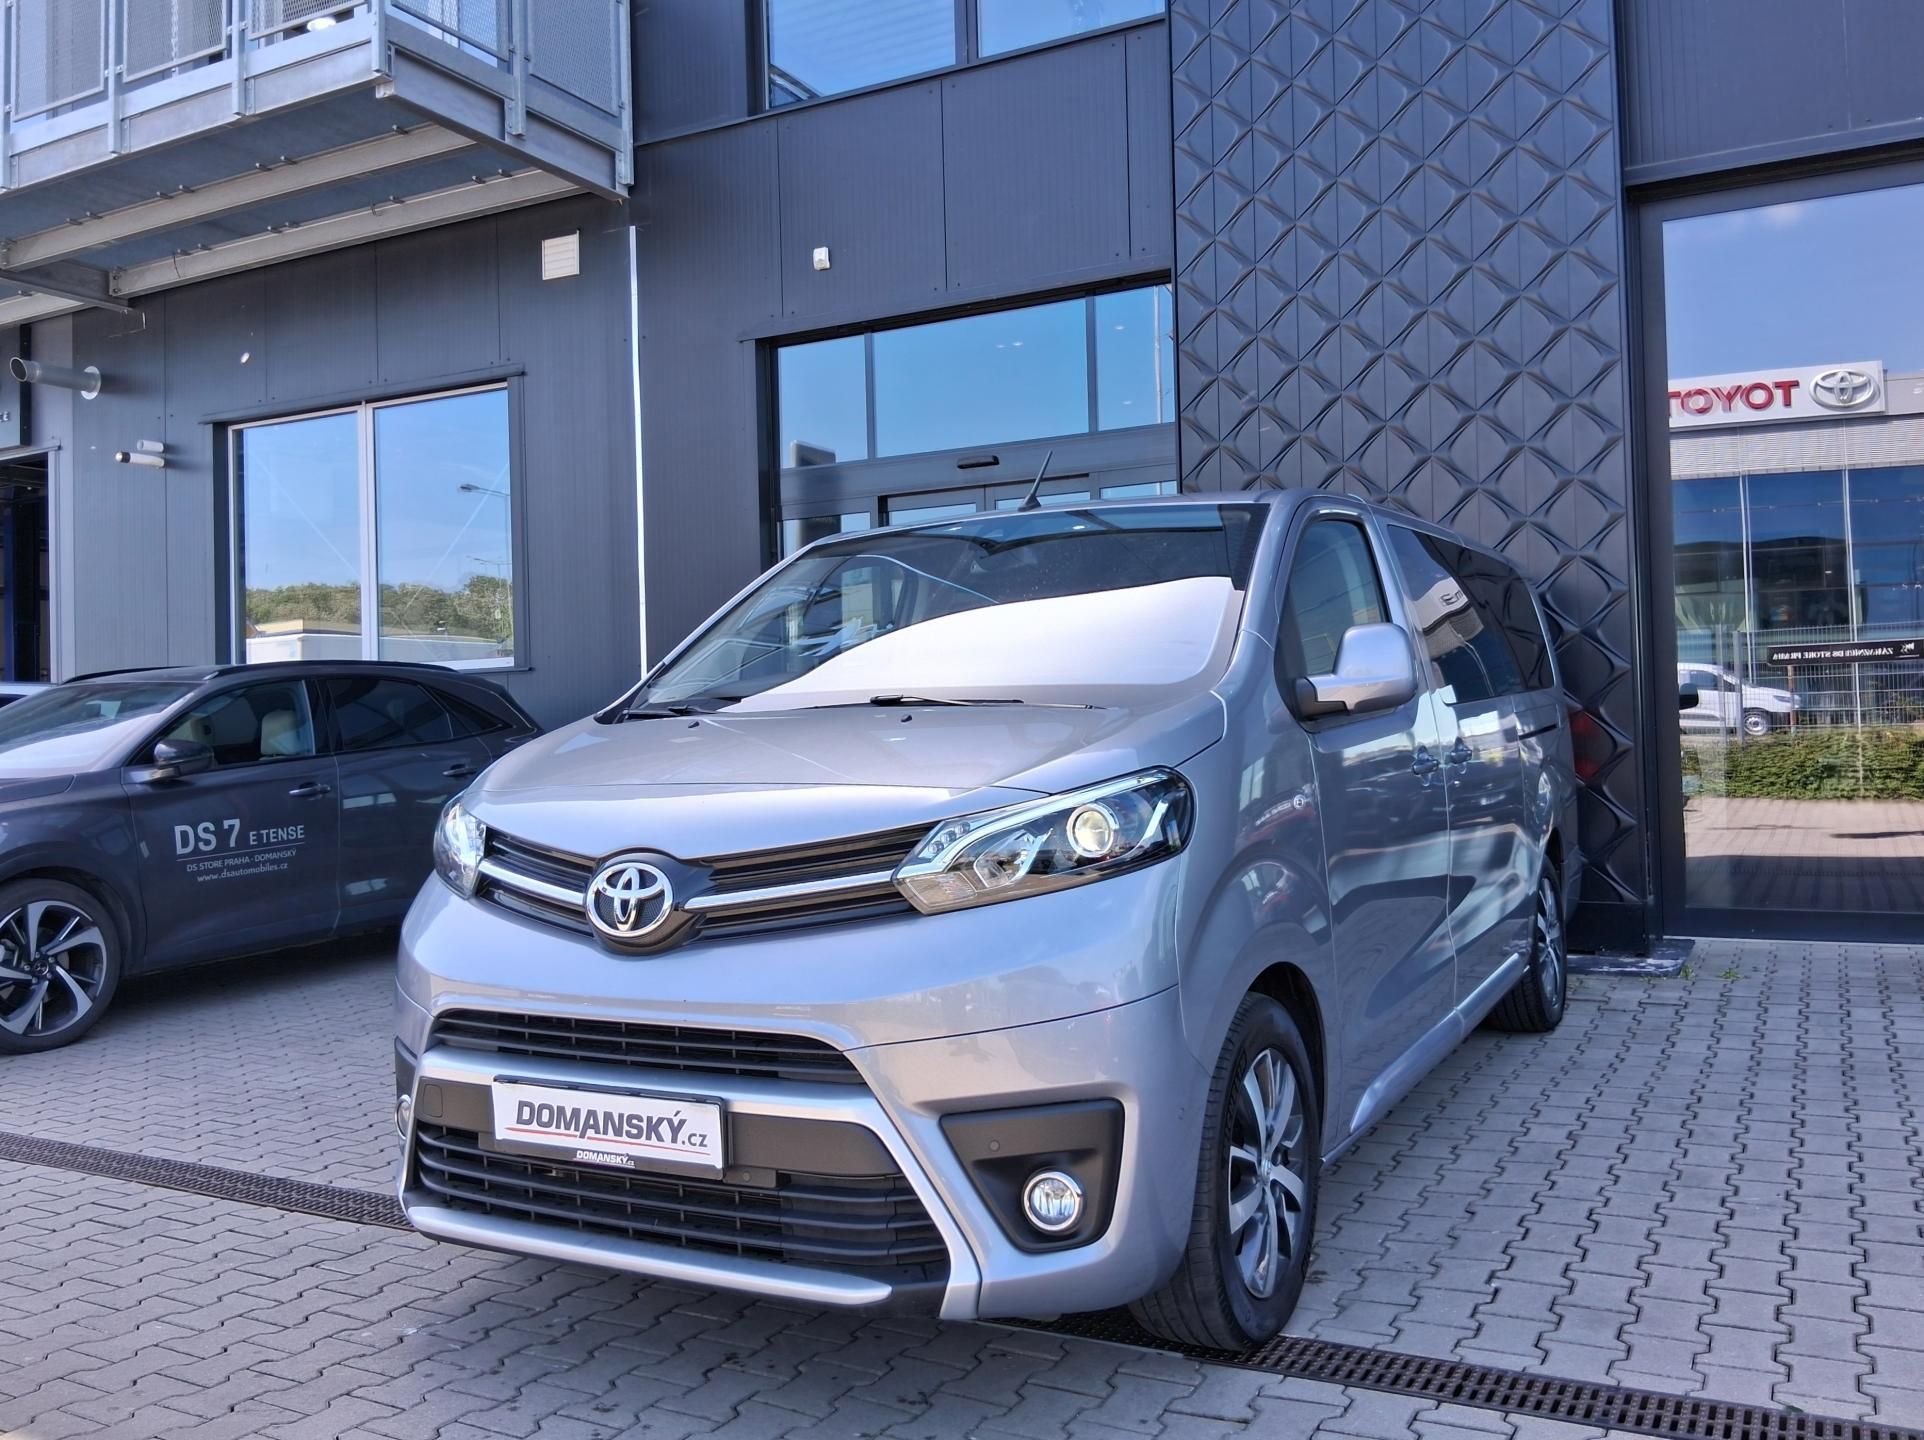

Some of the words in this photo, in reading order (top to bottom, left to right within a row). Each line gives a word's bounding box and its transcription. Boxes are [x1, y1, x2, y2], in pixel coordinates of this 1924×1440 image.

[174, 821, 217, 855] DS
[223, 818, 241, 848] 7
[249, 831, 258, 845] E
[259, 825, 305, 844] TENSE
[186, 863, 198, 872] DS
[199, 860, 224, 870] STORE
[224, 856, 250, 867] PRAHA
[197, 862, 289, 882] www.dsautomobiles.cz
